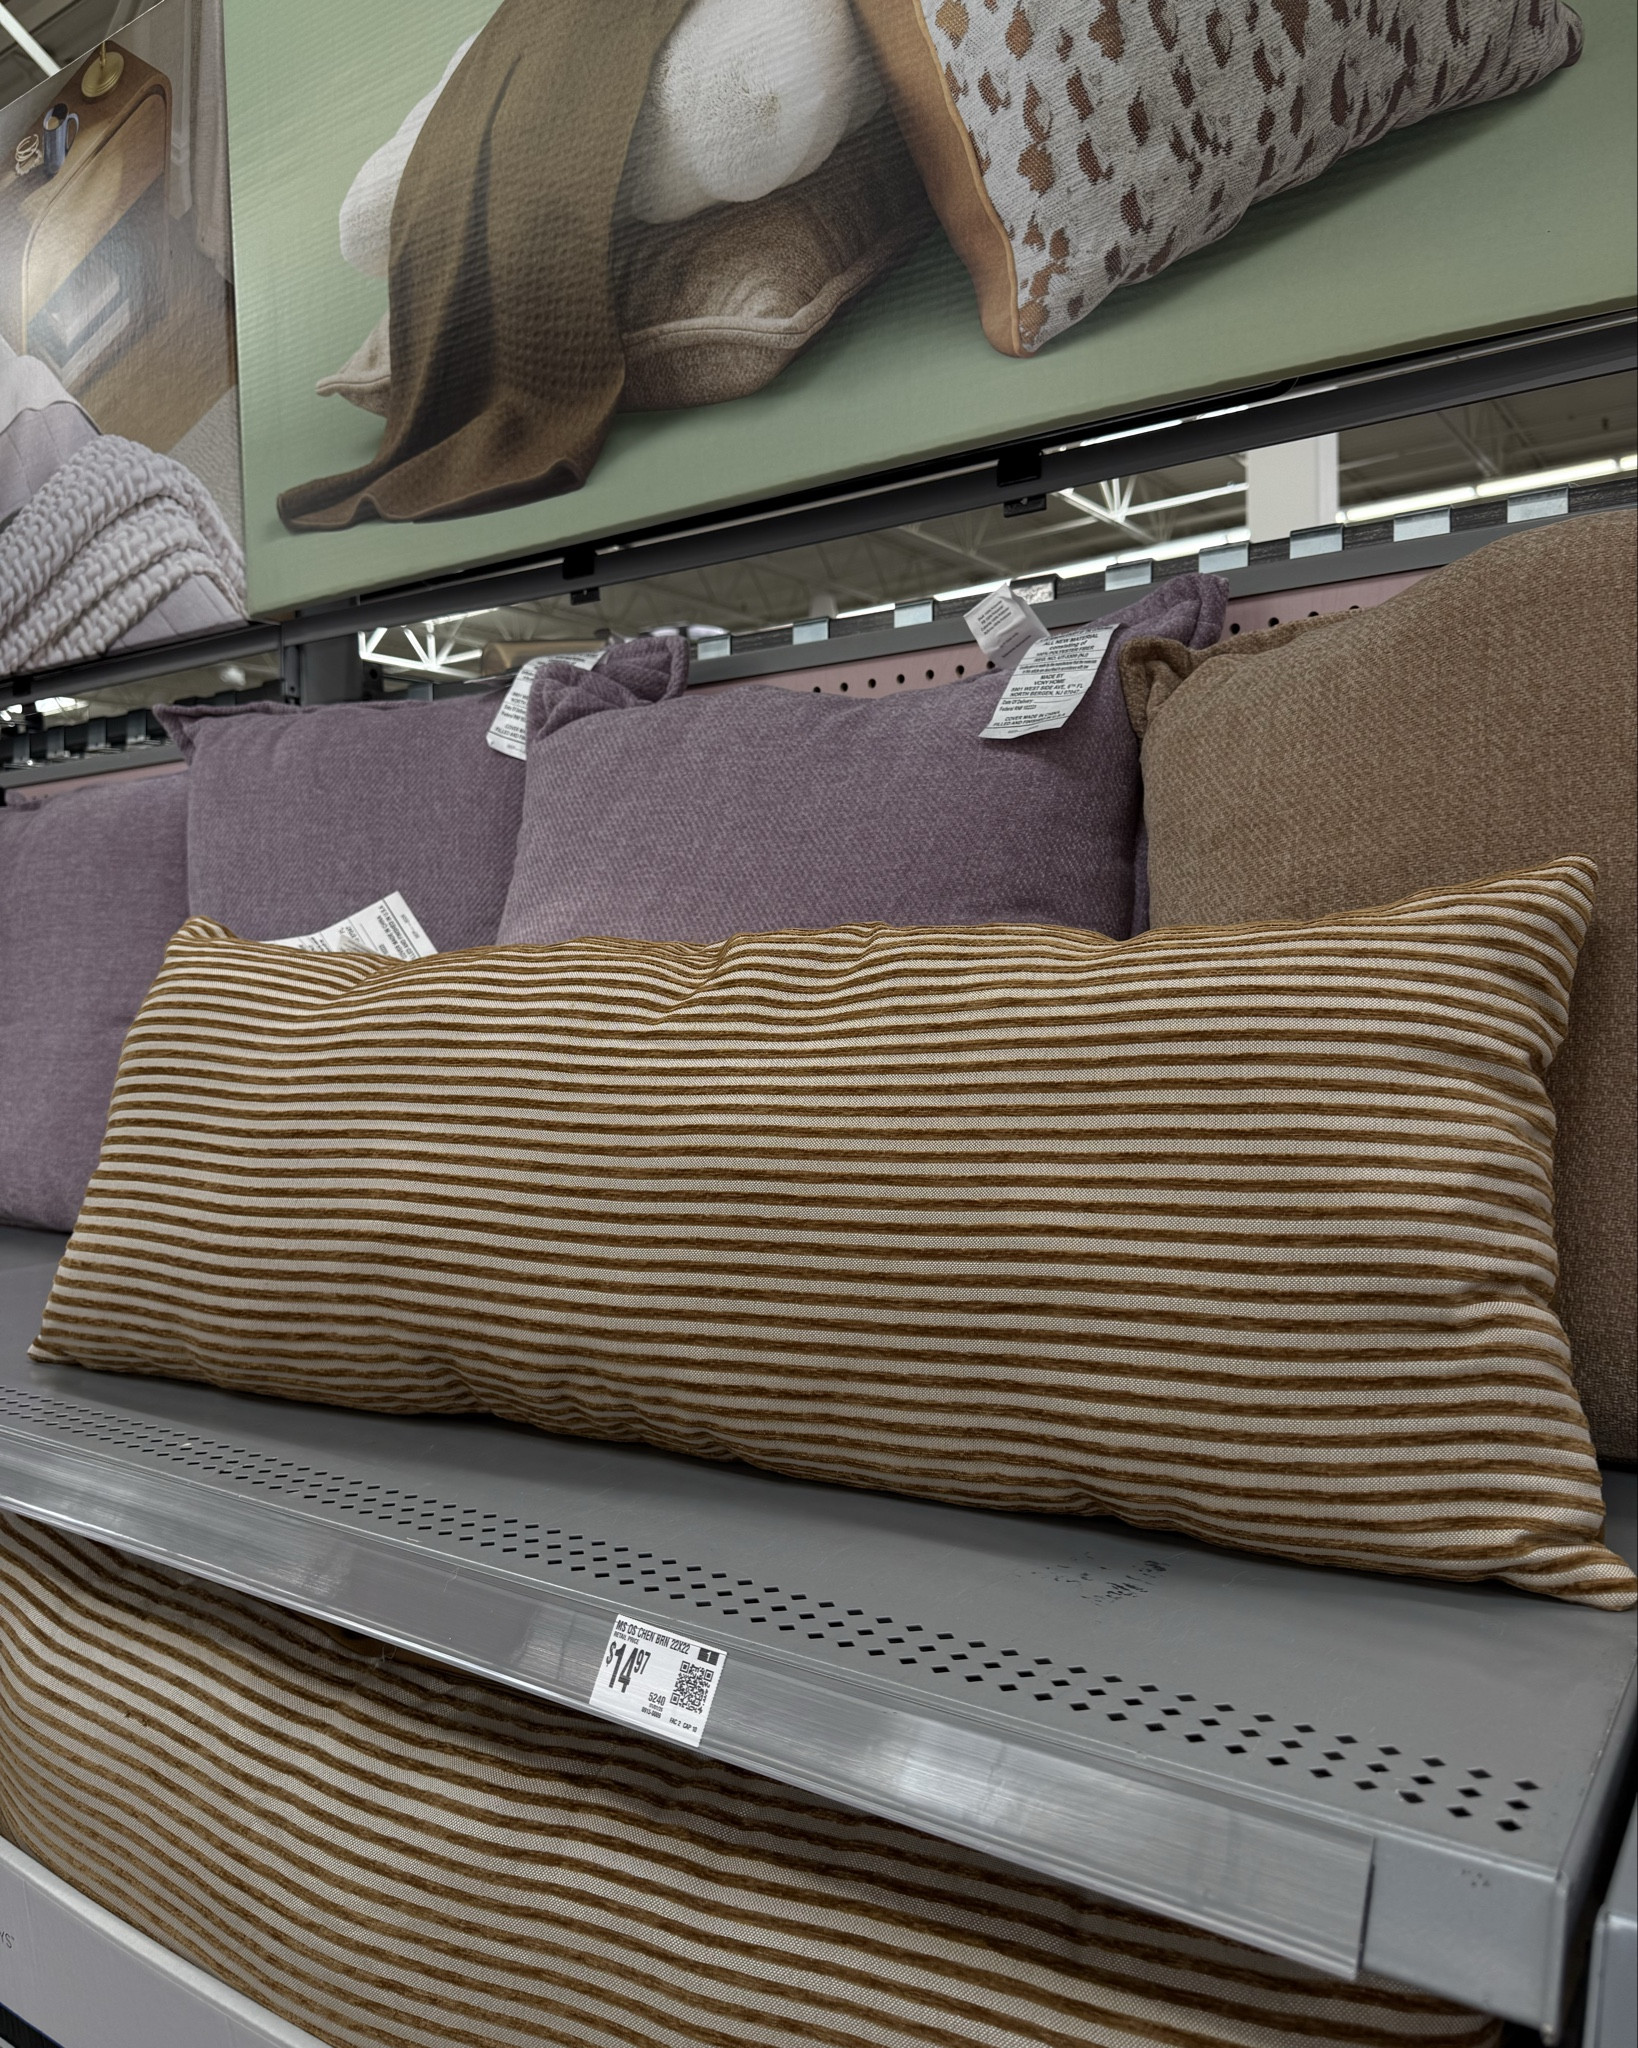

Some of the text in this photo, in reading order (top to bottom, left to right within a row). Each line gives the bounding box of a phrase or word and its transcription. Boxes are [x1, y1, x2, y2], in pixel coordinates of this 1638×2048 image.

[614, 1630, 639, 1645] RETAIL PRICE
[616, 1620, 691, 1655] MS OS CHEN BRN 22X22
[648, 1692, 666, 1706] 5240
